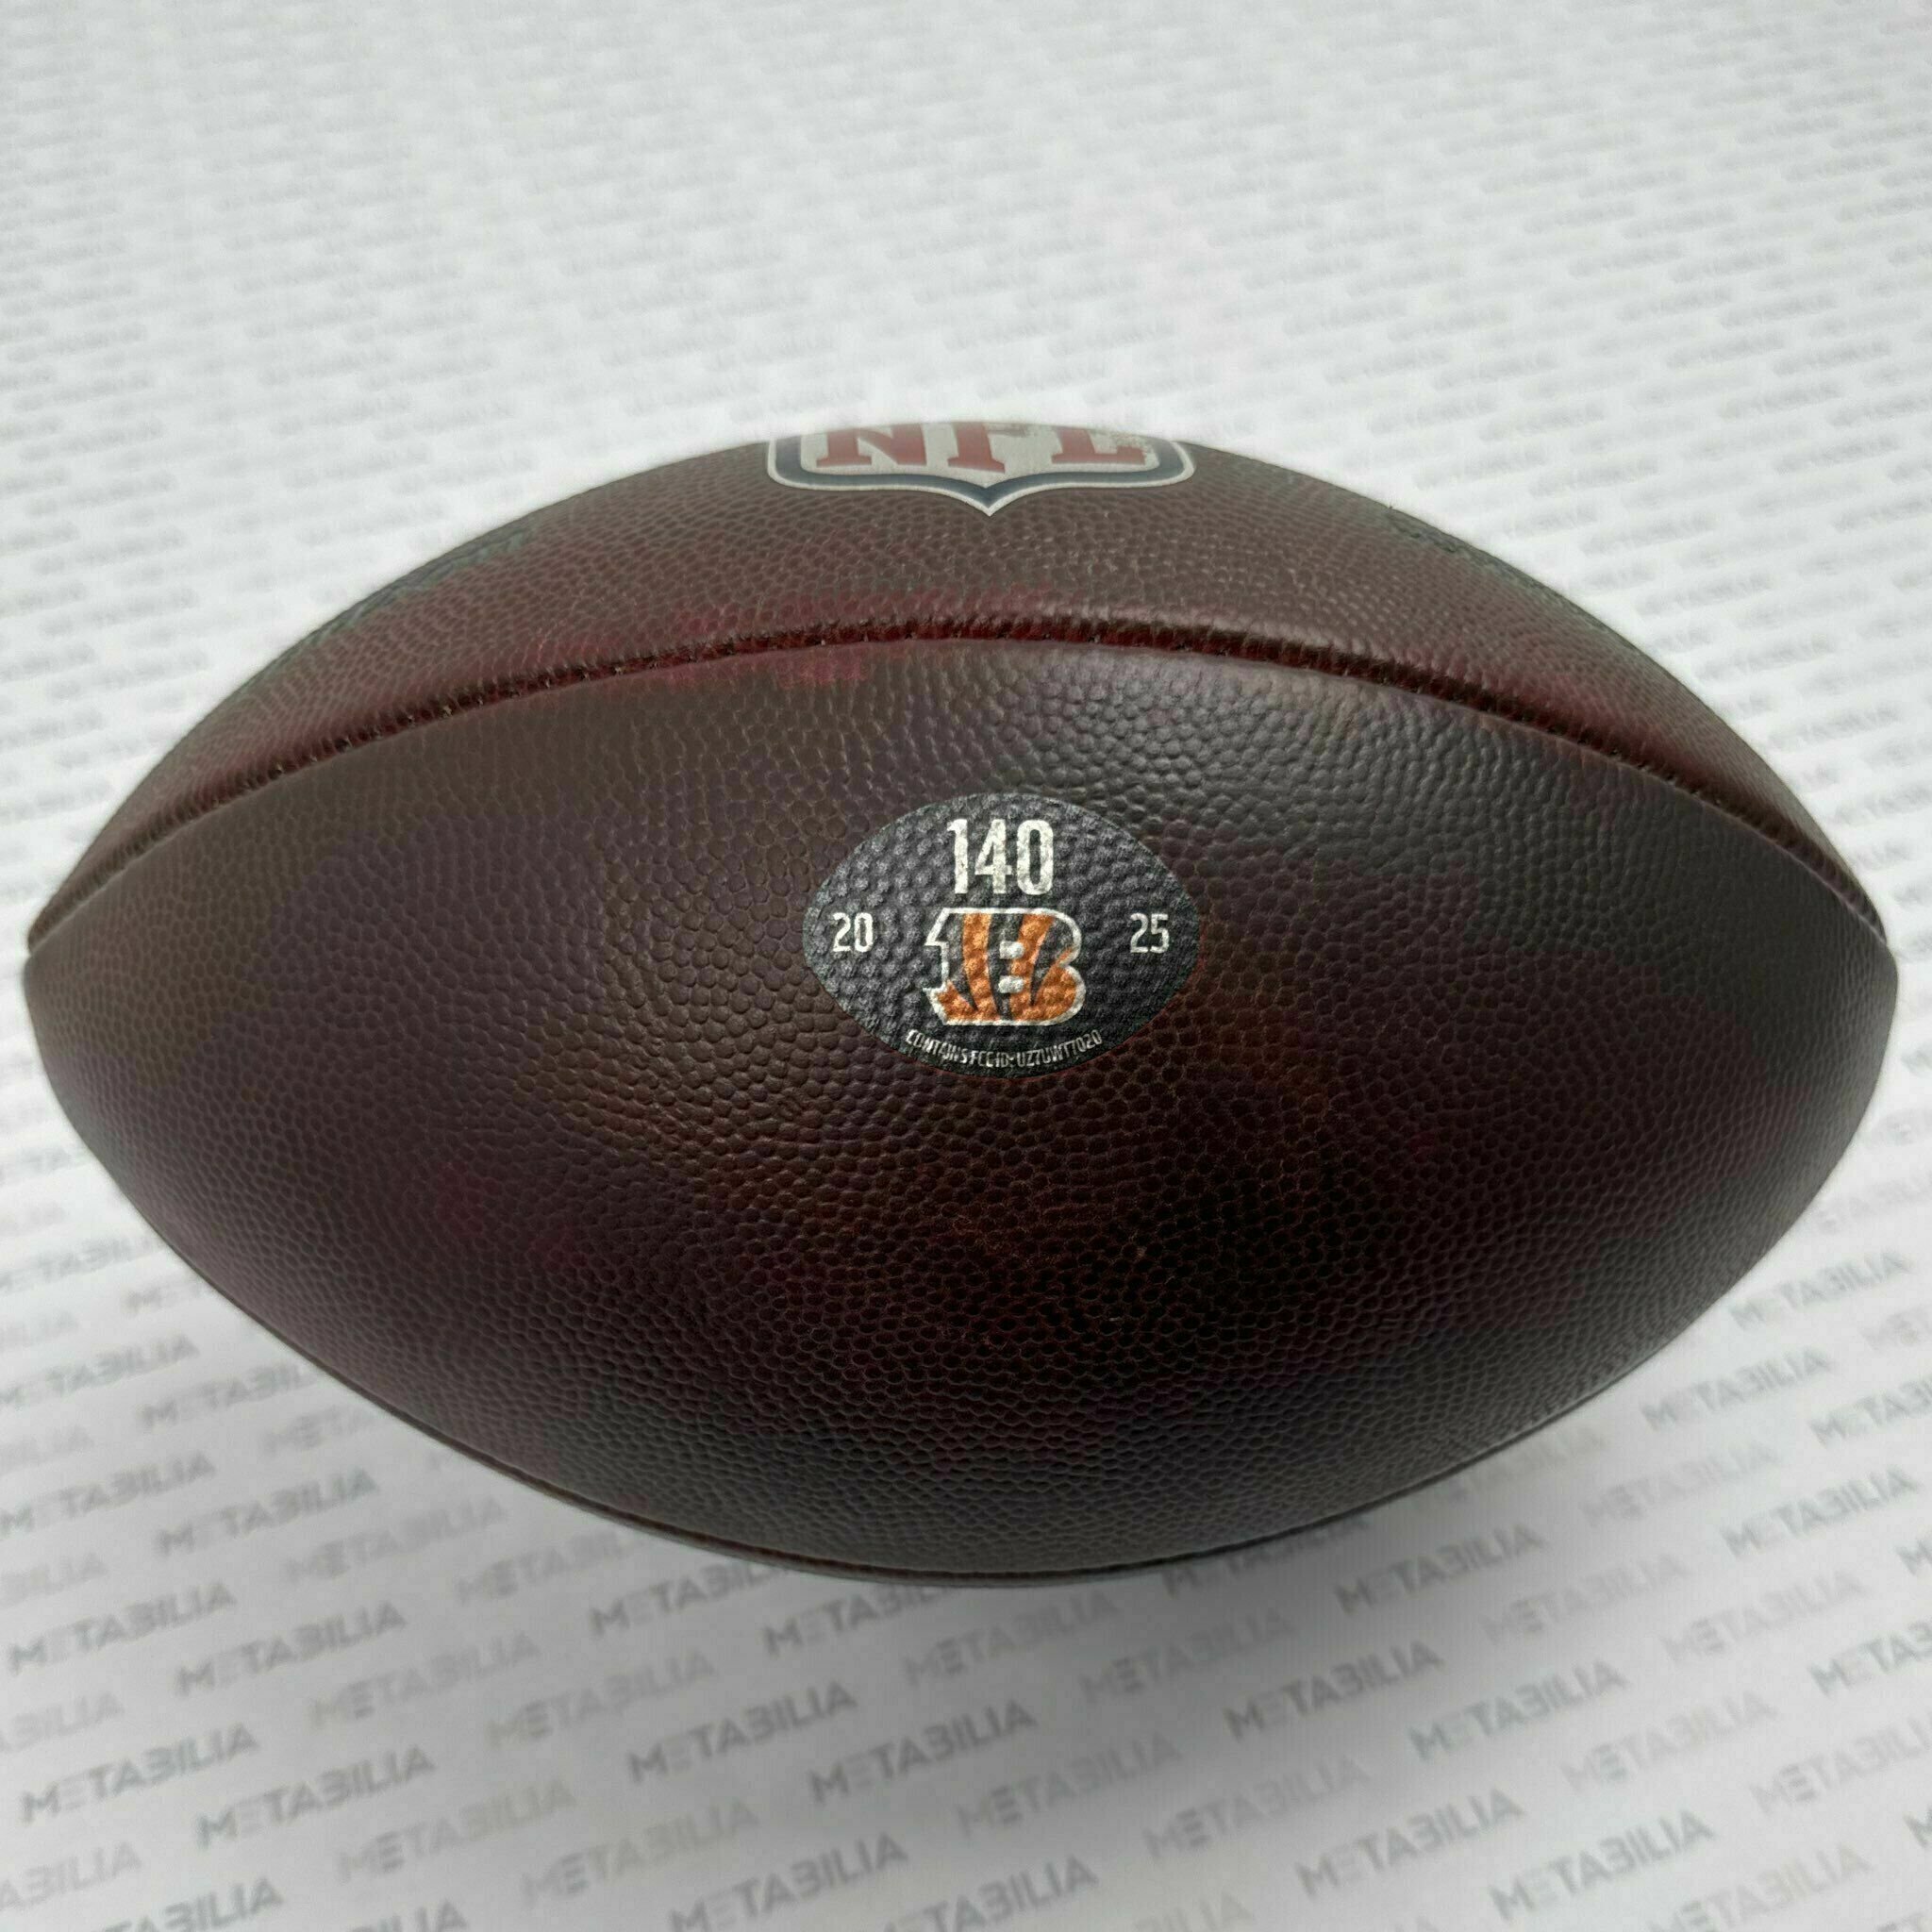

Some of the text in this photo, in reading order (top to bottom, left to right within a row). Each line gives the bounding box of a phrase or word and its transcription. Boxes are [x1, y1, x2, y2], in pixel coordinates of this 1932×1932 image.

[816, 421, 1145, 473] NFL
[946, 818, 1055, 895] 140
[832, 911, 874, 953] 20
[1129, 912, 1170, 954] 25
[905, 1028, 968, 1064] CONTAINS
[969, 1050, 994, 1068] FCC
